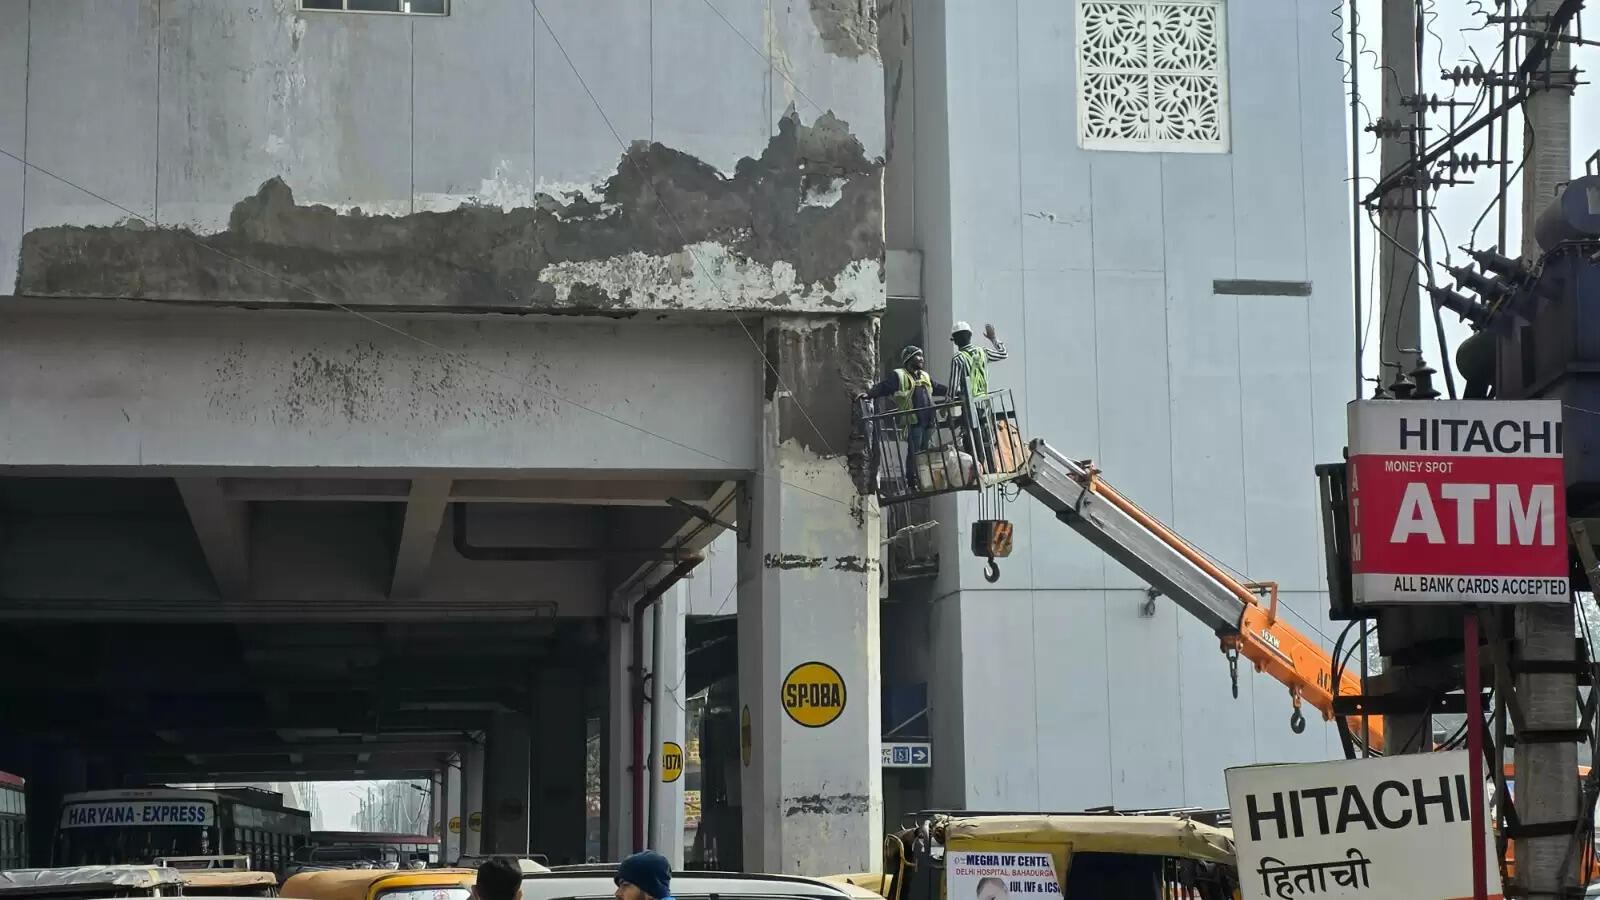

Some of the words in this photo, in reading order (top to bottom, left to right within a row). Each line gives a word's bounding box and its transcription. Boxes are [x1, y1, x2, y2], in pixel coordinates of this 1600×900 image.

[1400, 417, 1562, 453] HITACHI
[1385, 460, 1423, 473] MONEY
[1425, 462, 1453, 473] SPOT
[1351, 463, 1361, 561] ATM
[1390, 482, 1556, 546] ATM
[1394, 576, 1417, 592] ALL
[1420, 578, 1453, 592] BANK
[1457, 578, 1499, 593] CARDS
[1502, 580, 1567, 595] ACCEPTED
[1246, 774, 1470, 841] HITACHI
[956, 868, 975, 876] DELHI
[966, 855, 999, 866] MEGHA
[1001, 856, 1016, 866] IVF
[1256, 848, 1371, 900] हिताची
[1024, 882, 1036, 892] IVF
[1038, 884, 1043, 892] &
